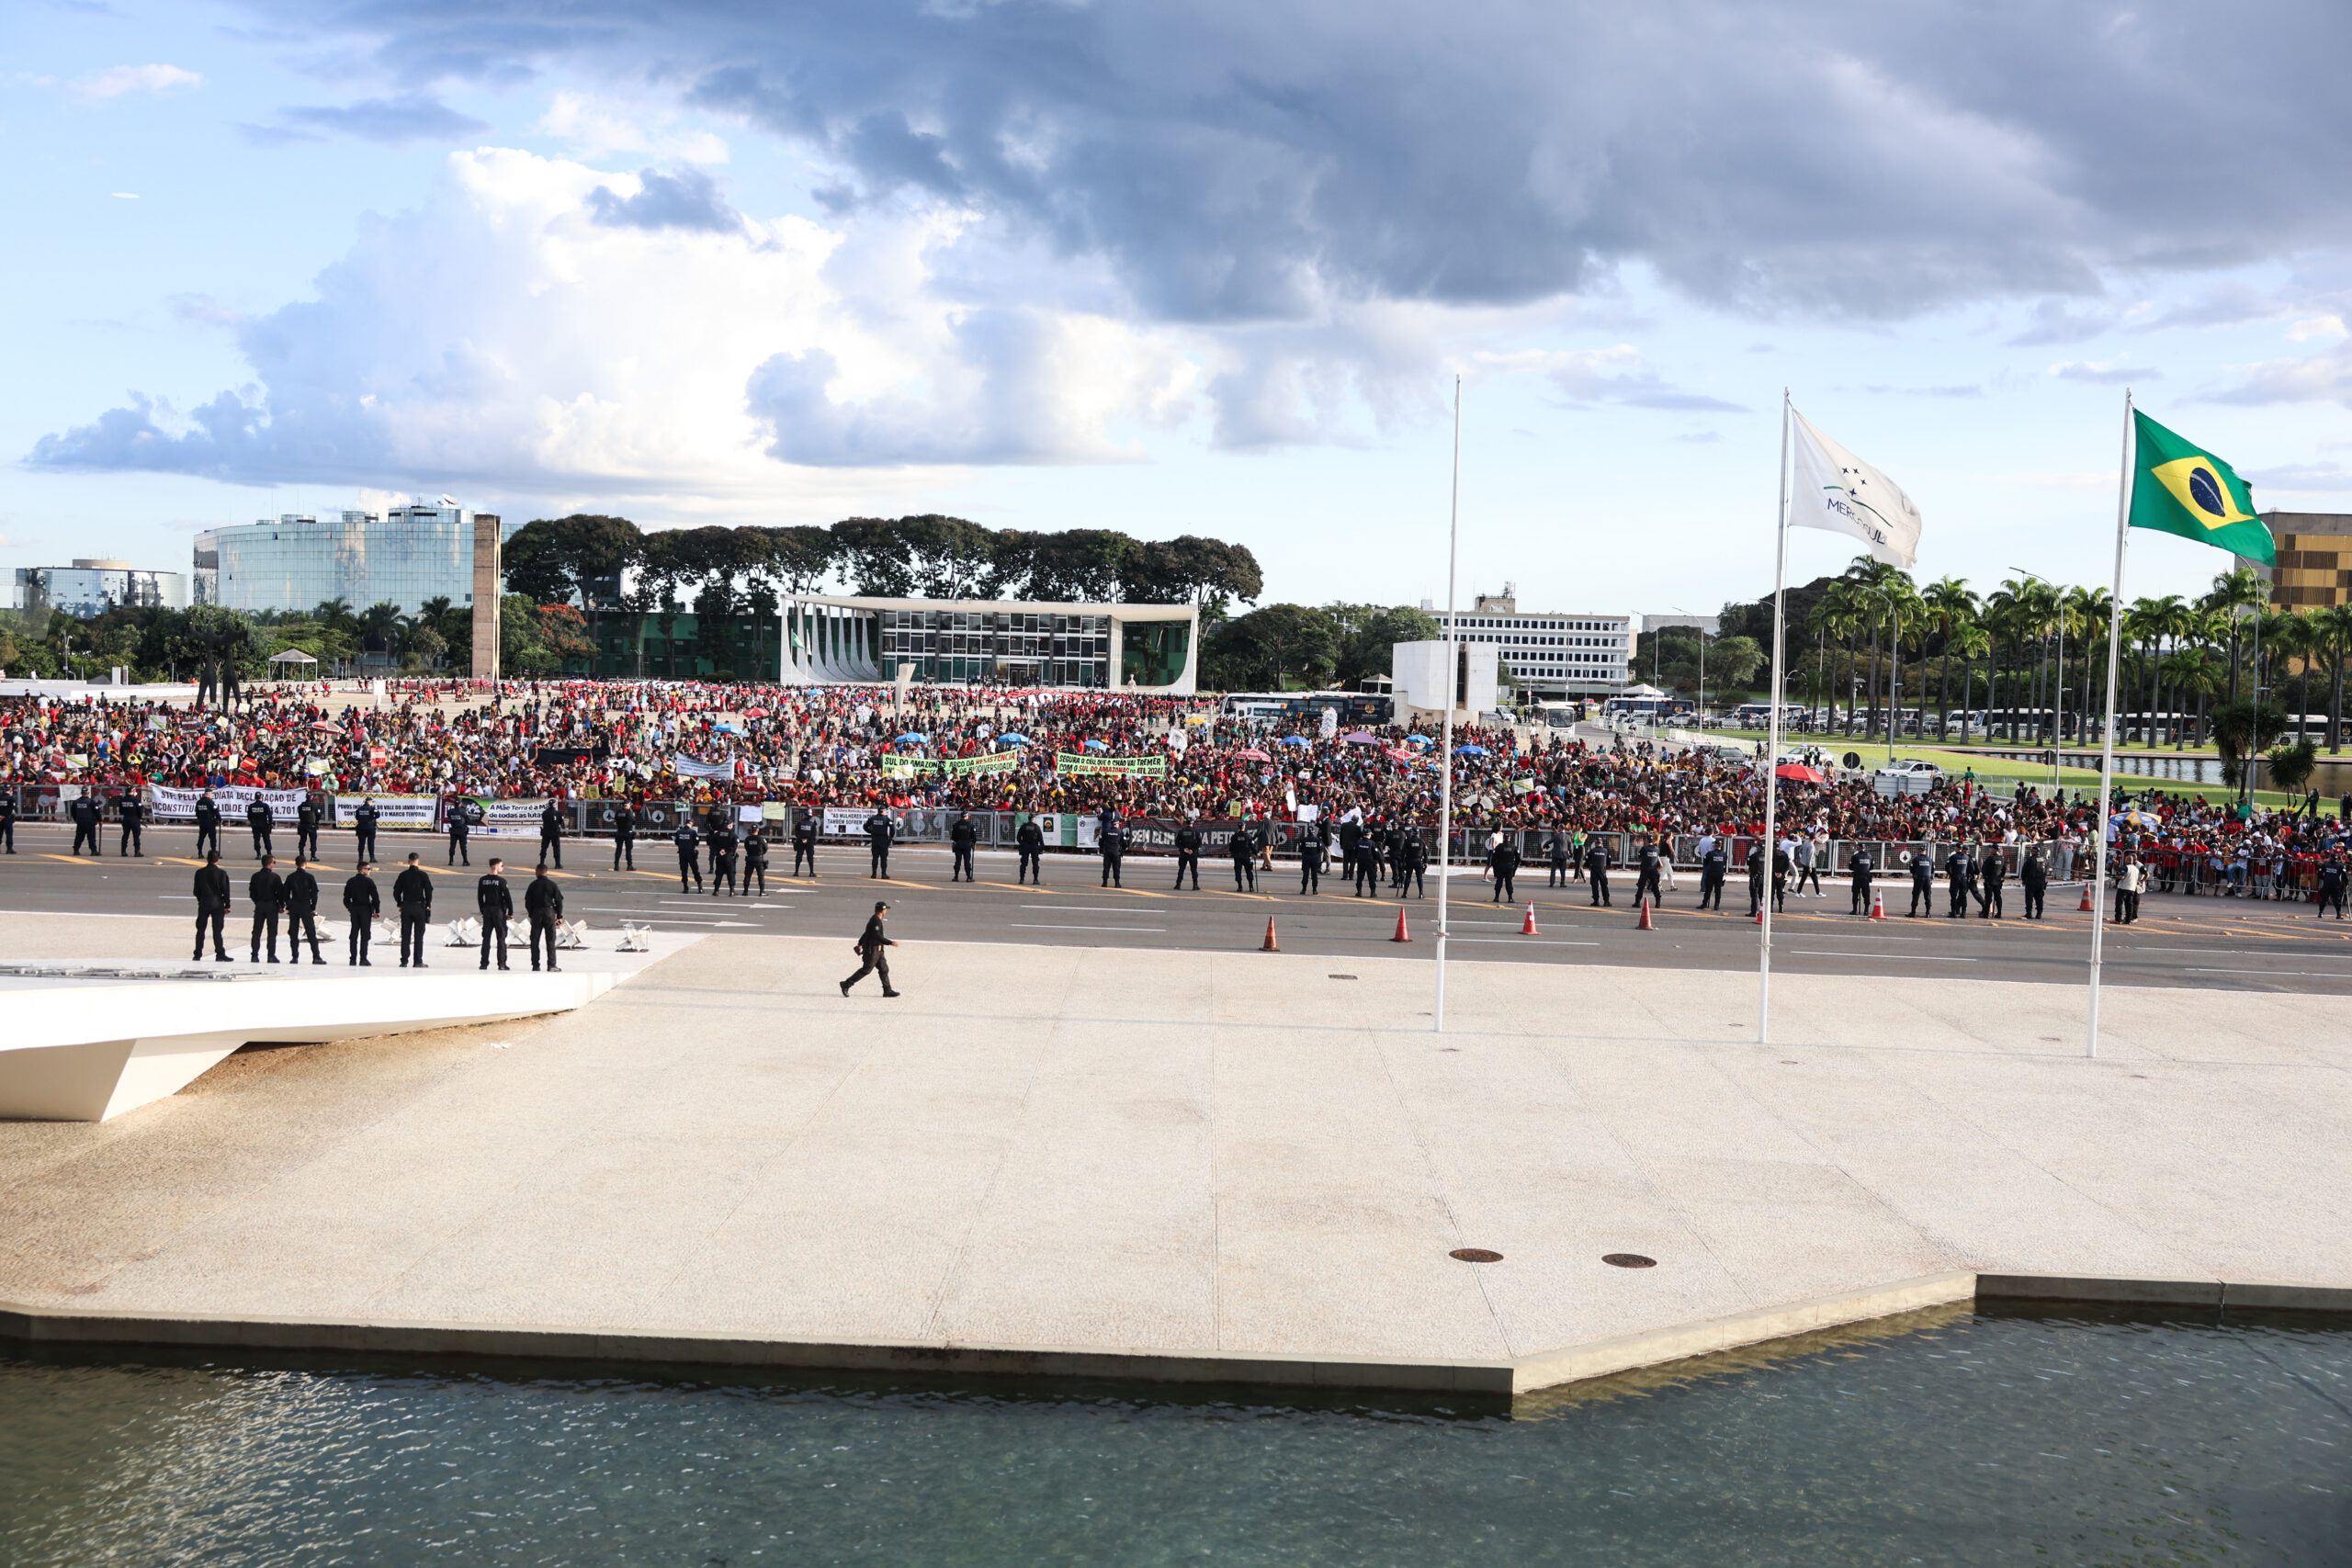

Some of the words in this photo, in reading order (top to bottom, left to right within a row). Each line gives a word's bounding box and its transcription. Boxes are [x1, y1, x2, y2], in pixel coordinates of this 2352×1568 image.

[884, 756, 897, 765] SUL
[910, 760, 946, 768] AMAZONAS
[1059, 755, 1080, 764] SEGURA
[1137, 758, 1161, 766] TREMER
[286, 793, 296, 802] DE
[1132, 829, 1150, 843] SEM
